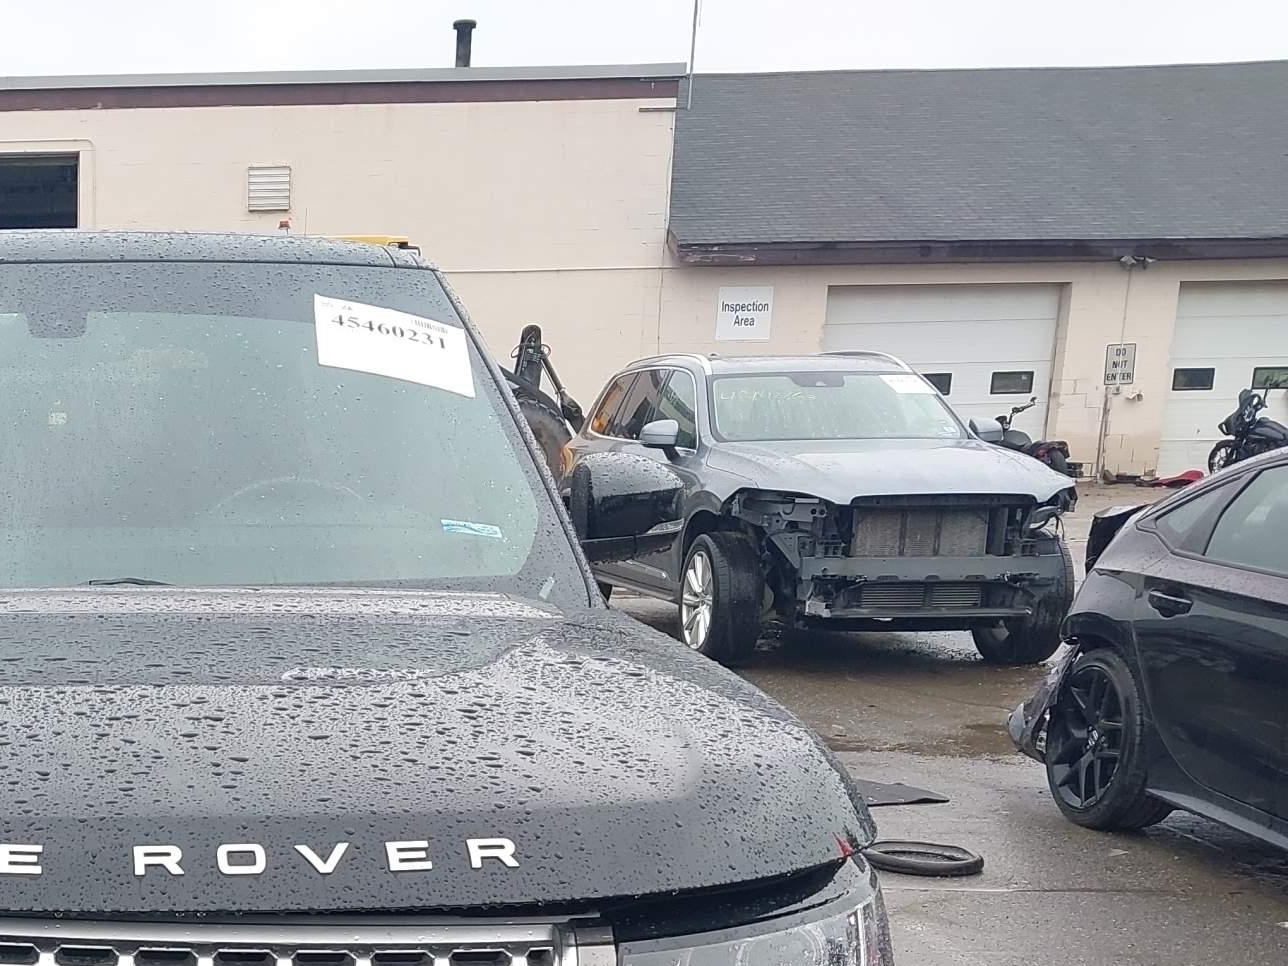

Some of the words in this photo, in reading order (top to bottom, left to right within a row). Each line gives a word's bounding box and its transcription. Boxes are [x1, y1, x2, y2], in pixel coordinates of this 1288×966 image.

[721, 300, 769, 314] Inspection
[733, 315, 755, 327] Area
[331, 314, 446, 349] 45460231
[1115, 347, 1127, 356] DO
[1106, 372, 1132, 381] ENTER
[132, 837, 521, 876] ROVER
